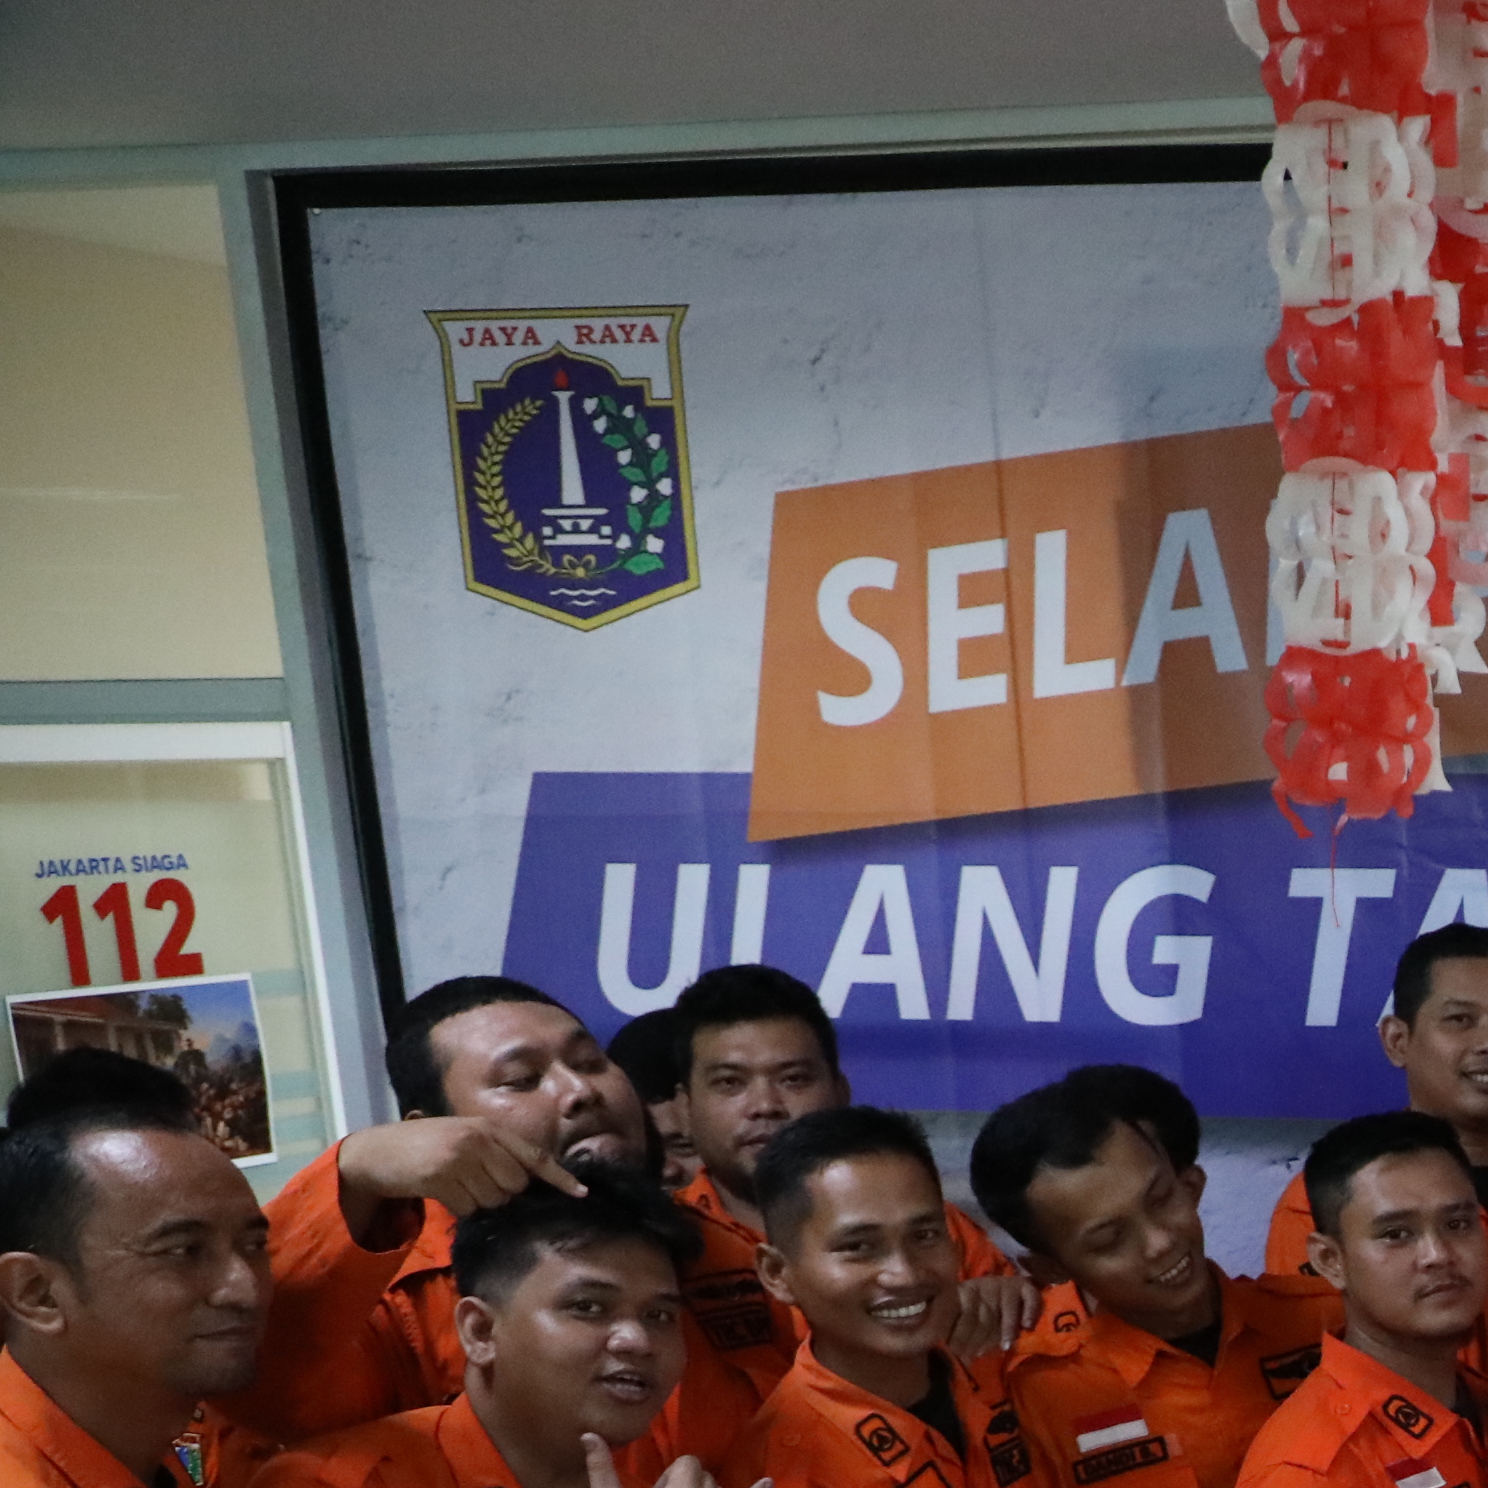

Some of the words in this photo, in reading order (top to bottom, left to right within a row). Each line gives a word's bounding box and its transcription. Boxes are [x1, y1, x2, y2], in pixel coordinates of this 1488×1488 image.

[457, 325, 542, 349] JAYA
[573, 321, 660, 345] RAYA
[35, 855, 126, 878] JAKARTA
[133, 853, 189, 873] SIAGA
[40, 877, 205, 987] 112
